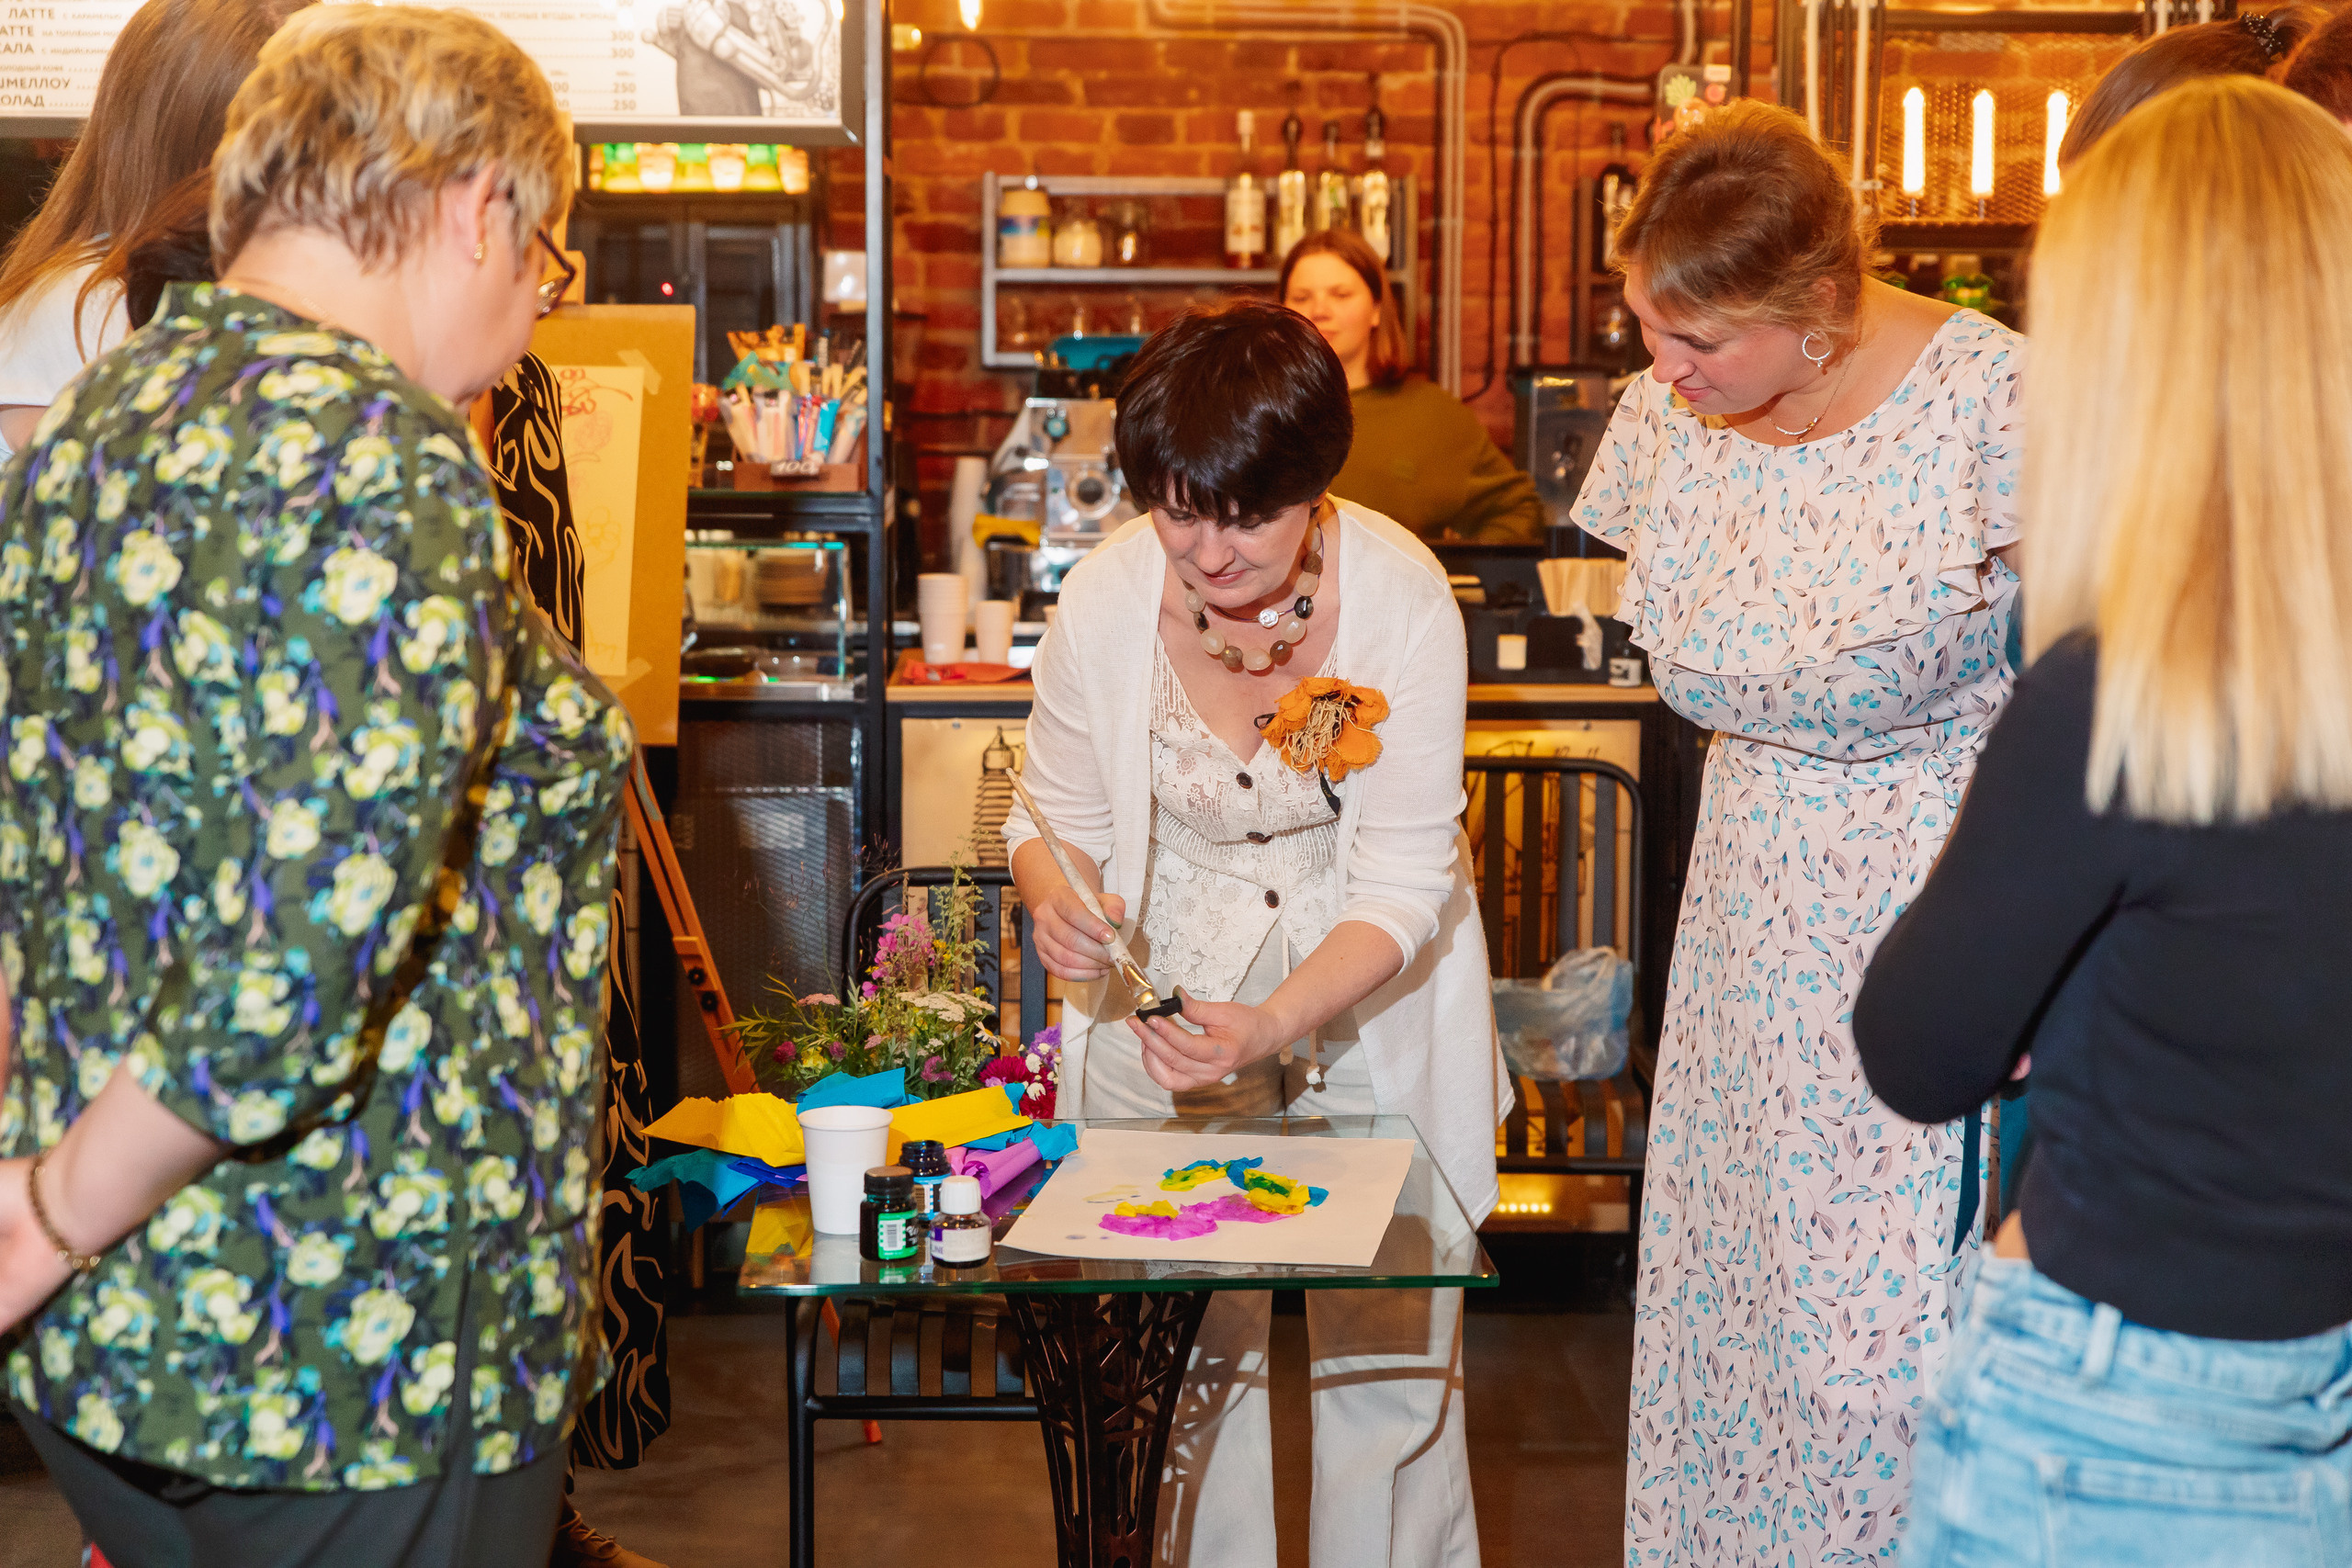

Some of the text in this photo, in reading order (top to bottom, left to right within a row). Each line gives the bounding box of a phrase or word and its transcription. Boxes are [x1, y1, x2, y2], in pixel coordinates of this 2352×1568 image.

[8, 7, 55, 20] ЛАТТЕ
[611, 29, 635, 41] 300
[0, 42, 34, 54] АЛА
[611, 47, 635, 59] 300
[613, 81, 637, 94] 250
[0, 95, 44, 107] ОЛАД
[613, 98, 637, 111] 250
